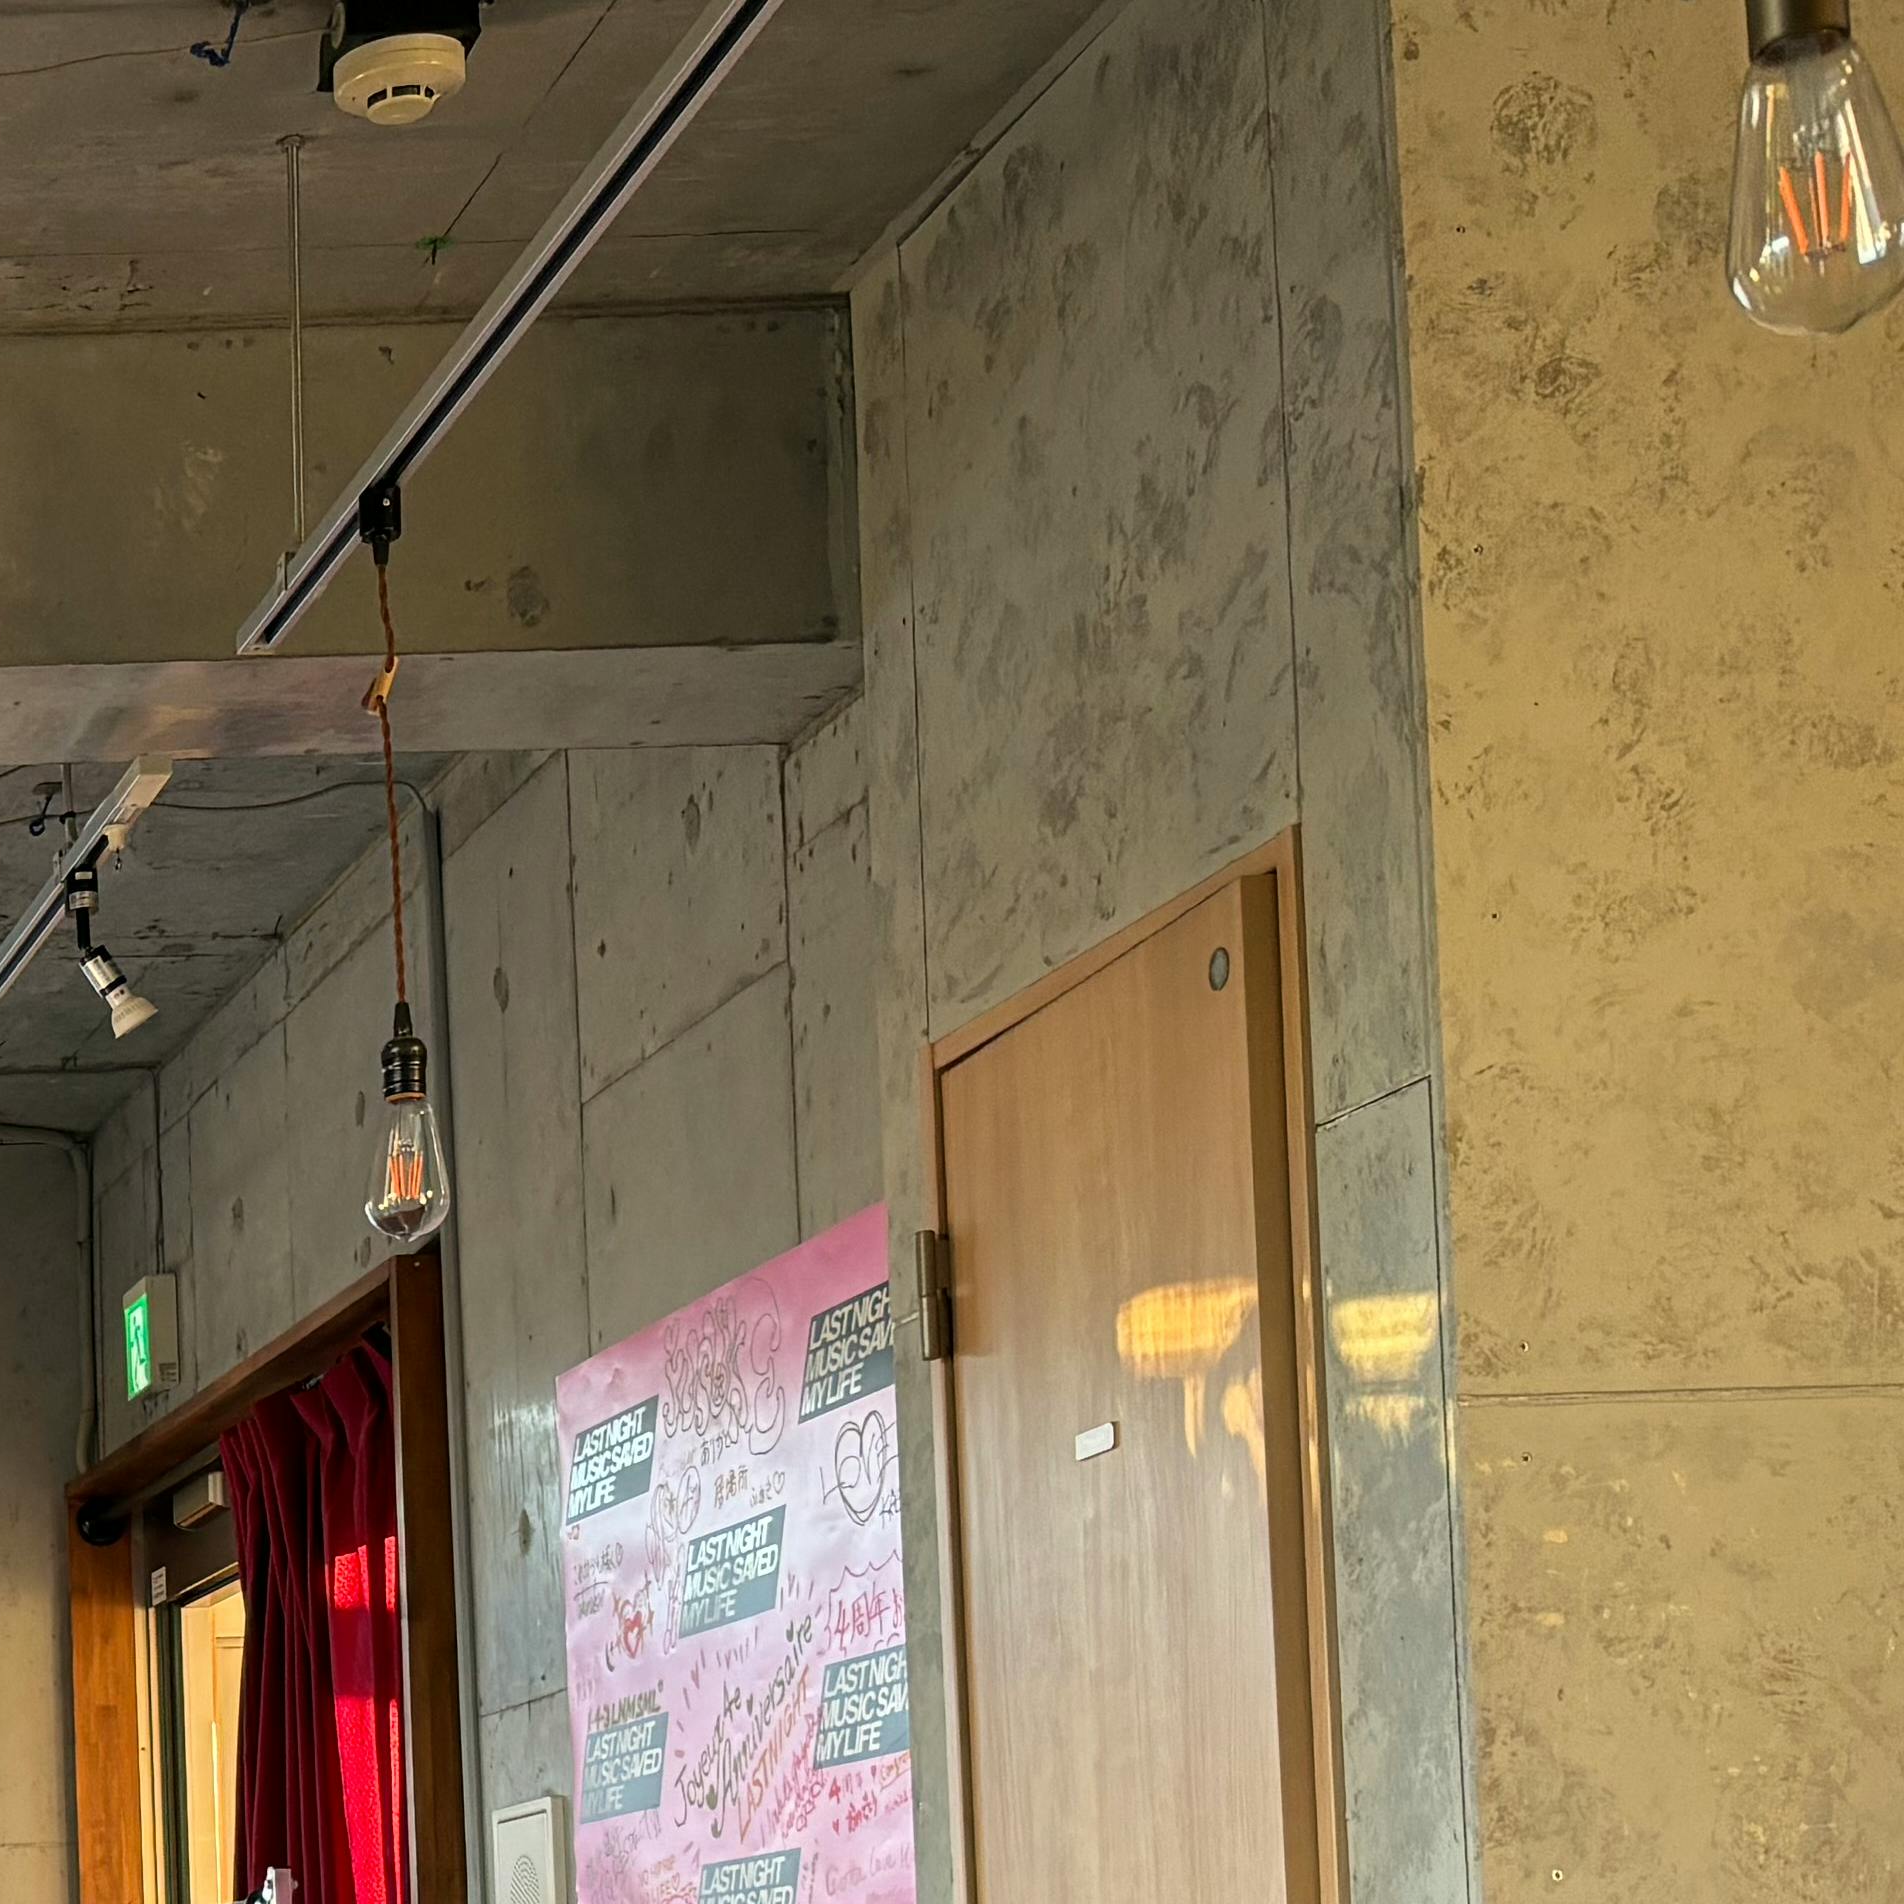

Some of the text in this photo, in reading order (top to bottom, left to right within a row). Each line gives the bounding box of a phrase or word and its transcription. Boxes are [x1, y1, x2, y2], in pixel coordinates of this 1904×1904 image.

[809, 1306, 854, 1350] LAST
[805, 1336, 857, 1381] MUSIC
[801, 1362, 864, 1416] MY LIFE
[574, 1406, 646, 1463] LAST NIGHT
[571, 1449, 612, 1490] MUSIC
[612, 1432, 654, 1473] SAVED
[568, 1476, 616, 1519] MY LIFE
[688, 1516, 773, 1573] LAST NIGHT
[684, 1544, 779, 1601] MUSIC SAVED
[681, 1589, 738, 1629] MY LIFE
[825, 1660, 869, 1698] LAST
[821, 1691, 876, 1731] MUSIC
[816, 1720, 882, 1761] MY LIFE
[702, 1864, 740, 1895] LAST
[740, 1856, 785, 1890] NIGHT
